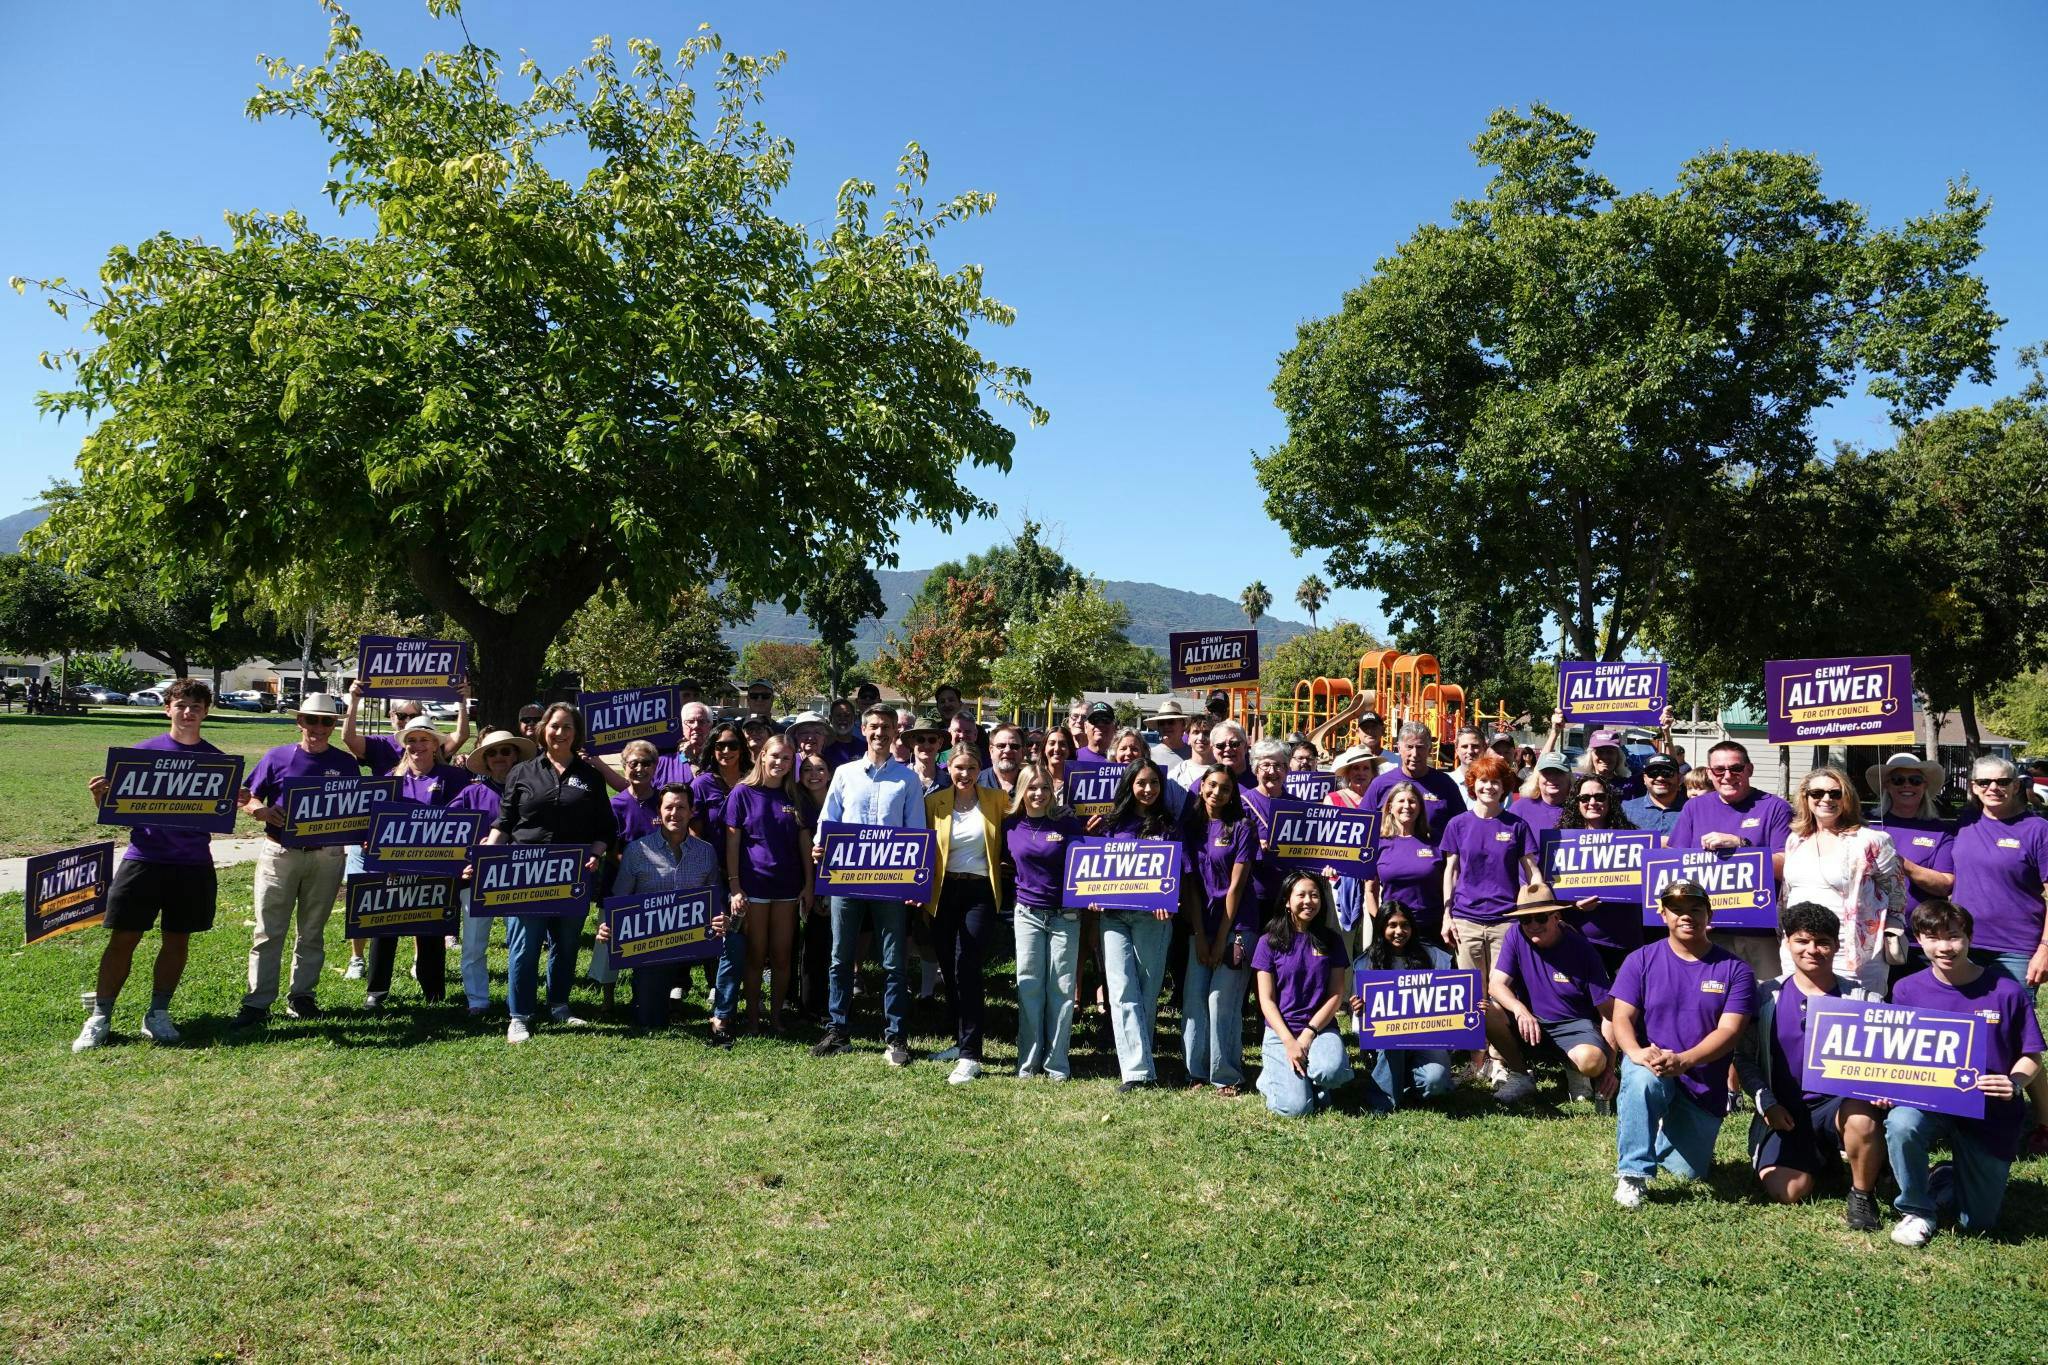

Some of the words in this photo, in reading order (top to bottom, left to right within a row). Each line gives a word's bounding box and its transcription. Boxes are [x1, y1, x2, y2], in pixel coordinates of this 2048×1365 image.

[396, 642, 427, 650] GENNY
[1201, 636, 1222, 644] GENNY
[1185, 642, 1241, 663] ALTWER
[369, 653, 452, 674] ALTWER
[1596, 665, 1626, 675] GENNY
[1190, 672, 1240, 683] GennyAltwer.com
[1815, 665, 1850, 678] GENNY
[1570, 675, 1652, 699] ALTWER
[1788, 675, 1882, 706] ALTWER
[613, 691, 640, 704] GENNY
[1612, 701, 1639, 709] COUNCIL
[592, 699, 666, 731] ALTWER
[1803, 710, 1816, 719] FOR
[1838, 706, 1870, 715] COUNCIL
[632, 725, 656, 736] COUNCIL
[1797, 721, 1882, 735] GennyAltwer.com
[155, 759, 195, 770] GENNY
[117, 771, 224, 796] ALTWER
[1287, 774, 1310, 782] GENNY
[325, 780, 358, 791] GENNY
[1287, 782, 1330, 800] TWER
[412, 809, 445, 819] GENNY
[1307, 808, 1339, 818] GENNY
[343, 820, 369, 828] COUNCI
[379, 822, 472, 843] ALTWER
[860, 830, 893, 839] GENNY
[1278, 820, 1365, 844] ALTWER
[1579, 833, 1614, 844] GENNY
[1105, 842, 1137, 852] GENNY
[1320, 848, 1348, 857] COUNCIL
[512, 848, 546, 860] GENNY
[829, 842, 919, 866] ALTWER
[1552, 844, 1643, 871] ALTWER
[1683, 852, 1718, 865] GENNY
[58, 855, 79, 870] GENNY
[1076, 854, 1164, 878] ALTWER
[483, 859, 574, 888] ALTWER
[40, 861, 97, 901] ALTWER
[386, 875, 419, 886] GENNY
[358, 885, 446, 912] ALTWER
[530, 889, 560, 898] COUNCIL
[644, 894, 676, 909] GENNY
[1710, 897, 1741, 906] OUNCIL
[404, 912, 432, 920] COUNCIL
[619, 901, 704, 940] ALTWER
[633, 944, 646, 952] FOR
[648, 940, 664, 949] CITY
[666, 934, 695, 945] COUNCIL
[1398, 973, 1433, 986] GENNY
[1370, 985, 1464, 1018] ALTWER
[1864, 1009, 1915, 1024] GENNY
[1403, 1022, 1419, 1030] CITY
[1421, 1019, 1452, 1029] COUNCIL
[1822, 1024, 1960, 1063] ALTWER
[1841, 1065, 1860, 1075] FOR
[1864, 1067, 1888, 1078] CITY
[1891, 1069, 1936, 1082] COUNCIL
